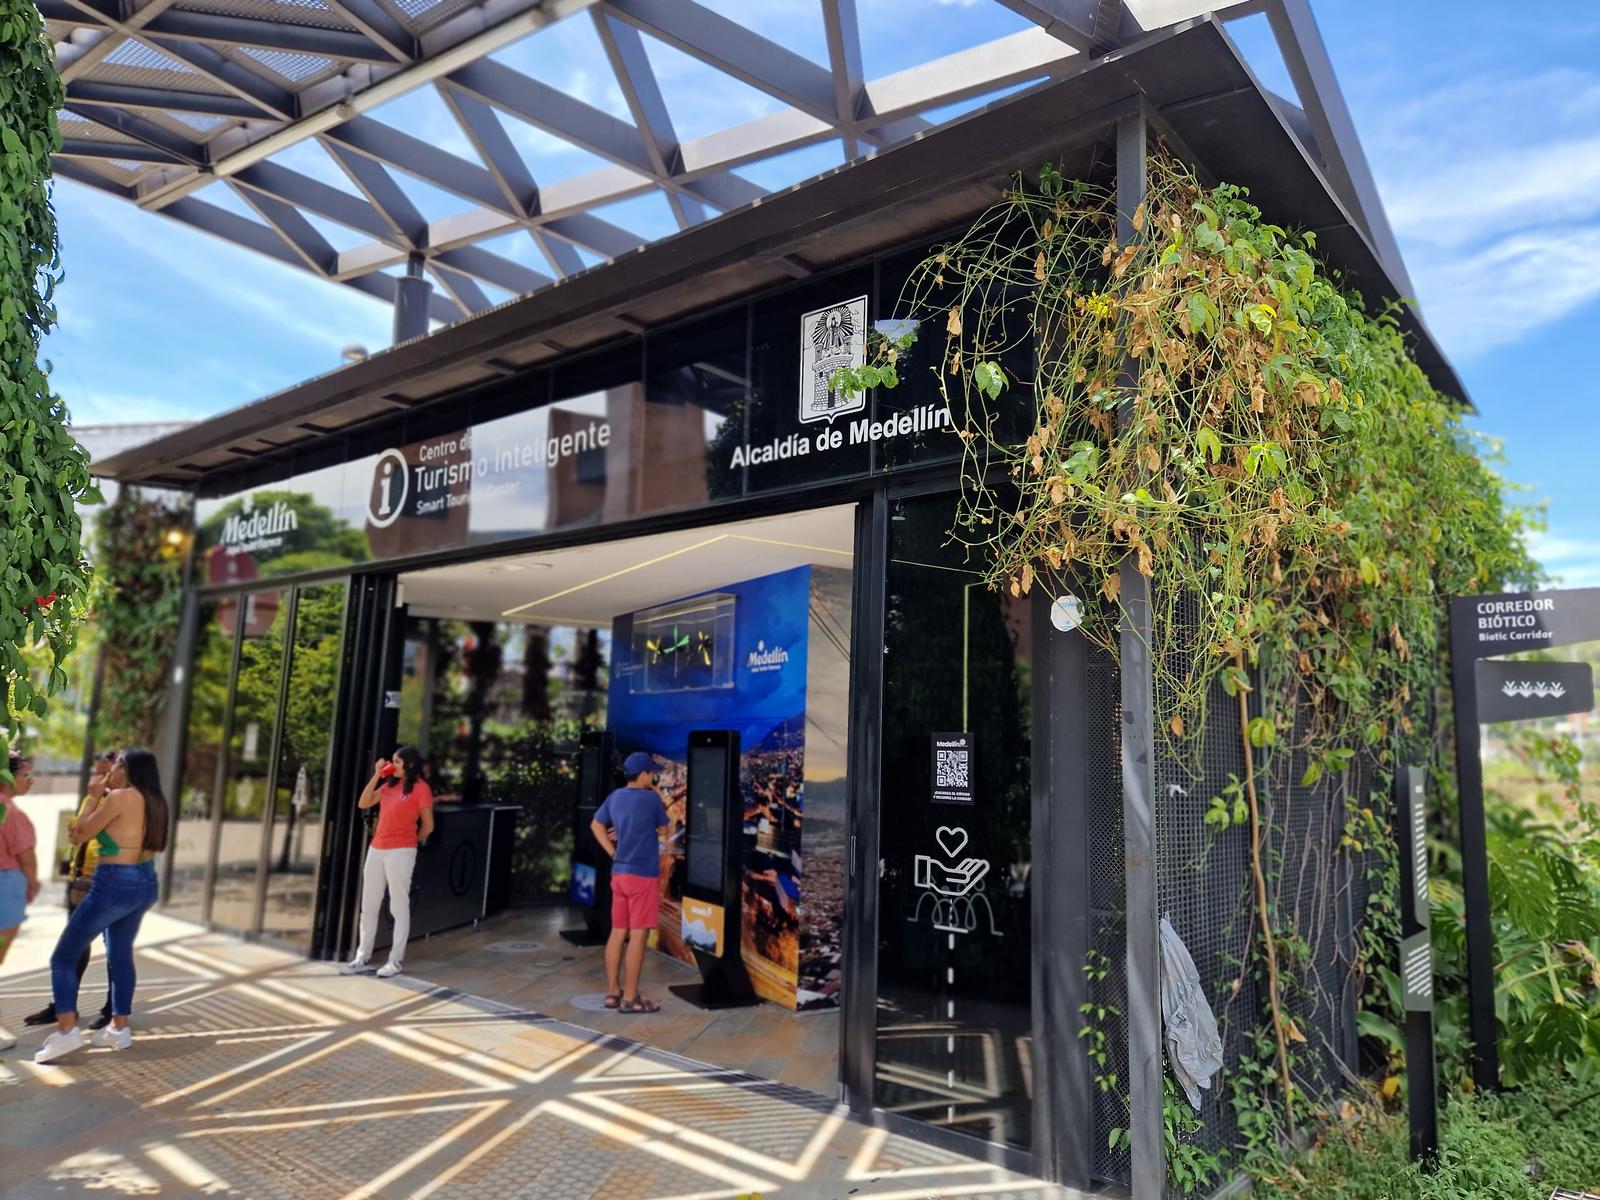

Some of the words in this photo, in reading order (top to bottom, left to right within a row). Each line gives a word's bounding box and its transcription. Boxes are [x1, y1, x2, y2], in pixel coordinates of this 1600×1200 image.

[730, 433, 810, 469] Alcaldía
[816, 427, 842, 451] de
[849, 403, 950, 445] Medellín
[415, 457, 488, 493] Turismo
[495, 423, 611, 473] Inteligente
[419, 440, 457, 462] Centro
[416, 498, 444, 516] Smart
[220, 501, 298, 545] Medellín
[1477, 599, 1554, 614] CORREDOR
[1478, 614, 1536, 629] BIÓTICO
[1479, 632, 1508, 641] Biotic
[1509, 630, 1554, 640] Corridor
[747, 646, 789, 667] Medellín
